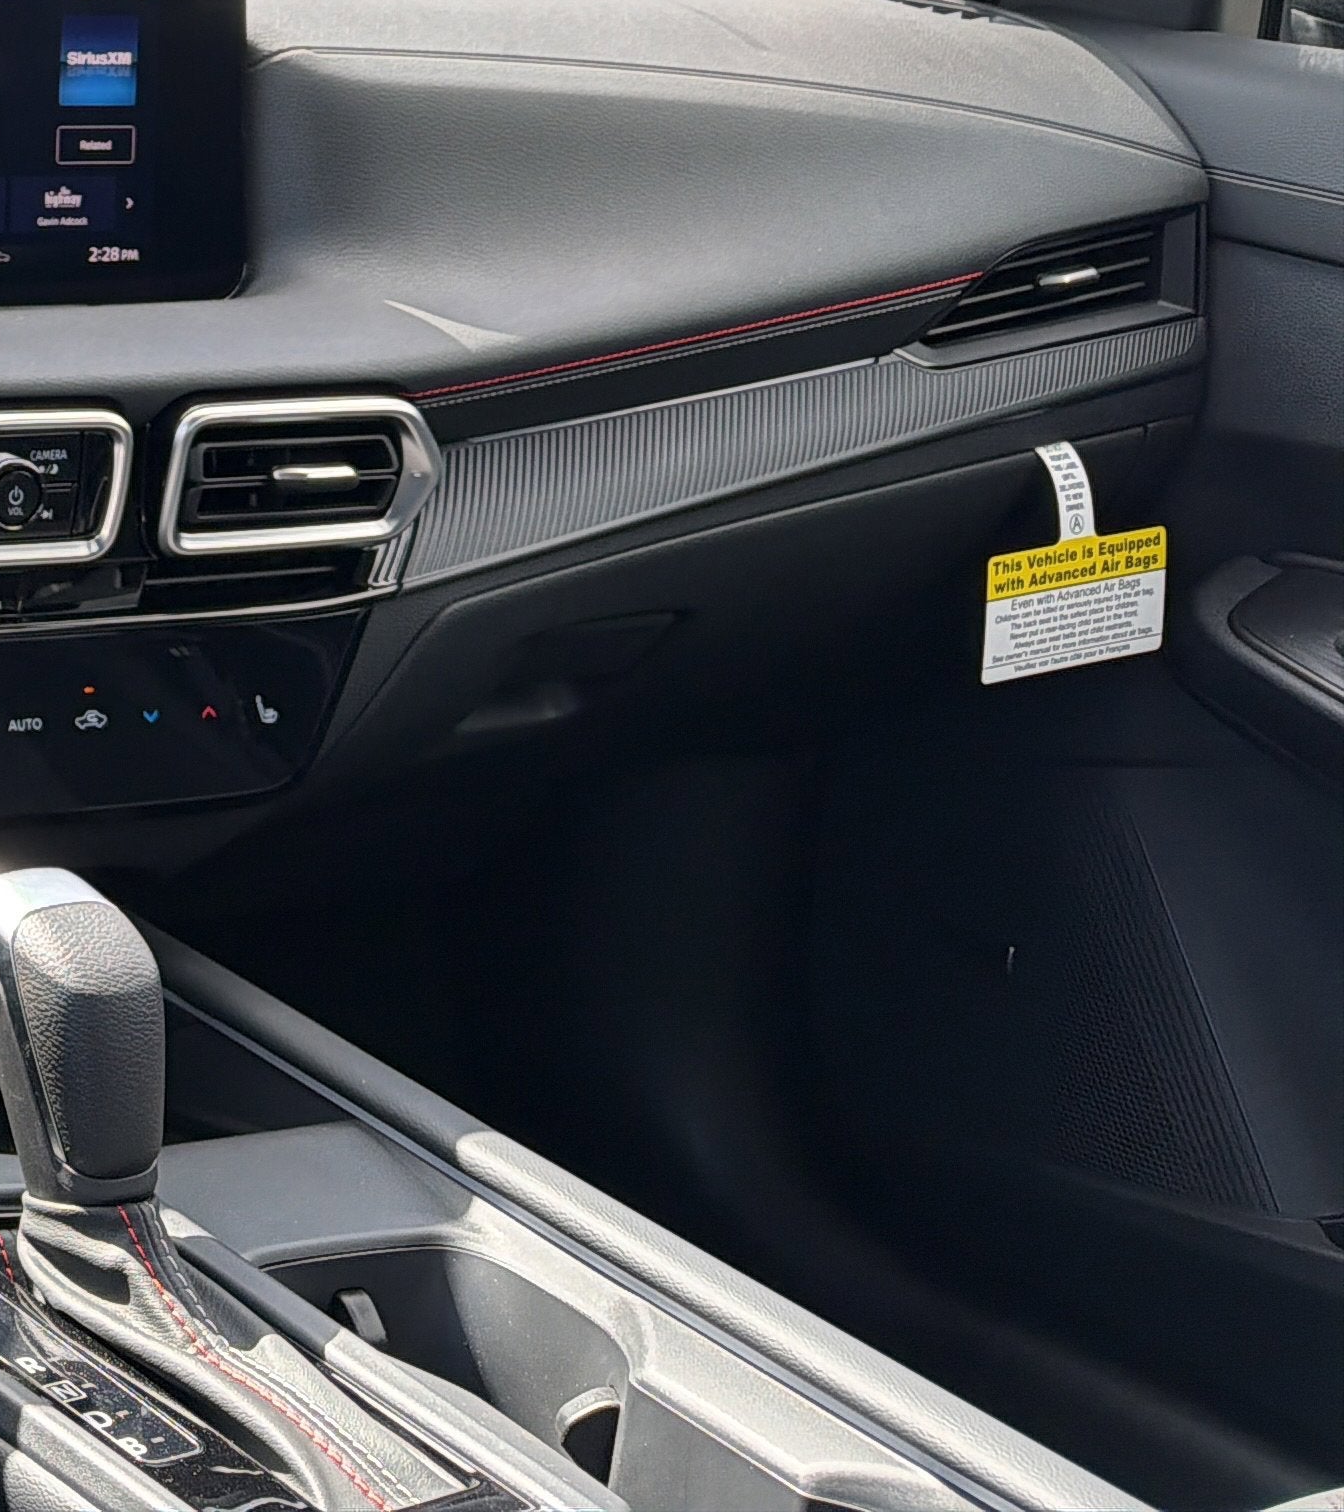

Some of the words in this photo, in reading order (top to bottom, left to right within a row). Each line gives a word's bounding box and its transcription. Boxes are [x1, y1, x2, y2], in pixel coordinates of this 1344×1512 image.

[88, 246, 120, 263] 2:28
[120, 248, 140, 261] PM
[29, 448, 68, 462] CAMERA
[993, 559, 1023, 576] This
[1027, 548, 1077, 570] Vehicle
[1098, 532, 1161, 556] Equipped
[994, 577, 1024, 594] with
[1029, 563, 1097, 588] Advanced
[1100, 559, 1121, 574] Air
[1125, 553, 1159, 570] Bags
[1011, 599, 1034, 611] Even
[1037, 593, 1056, 606] with
[1057, 584, 1102, 601] Advanced
[1103, 583, 1116, 594] Air
[1118, 578, 1141, 591] Bags
[8, 717, 43, 733] AUTO
[14, 1356, 47, 1374] R
